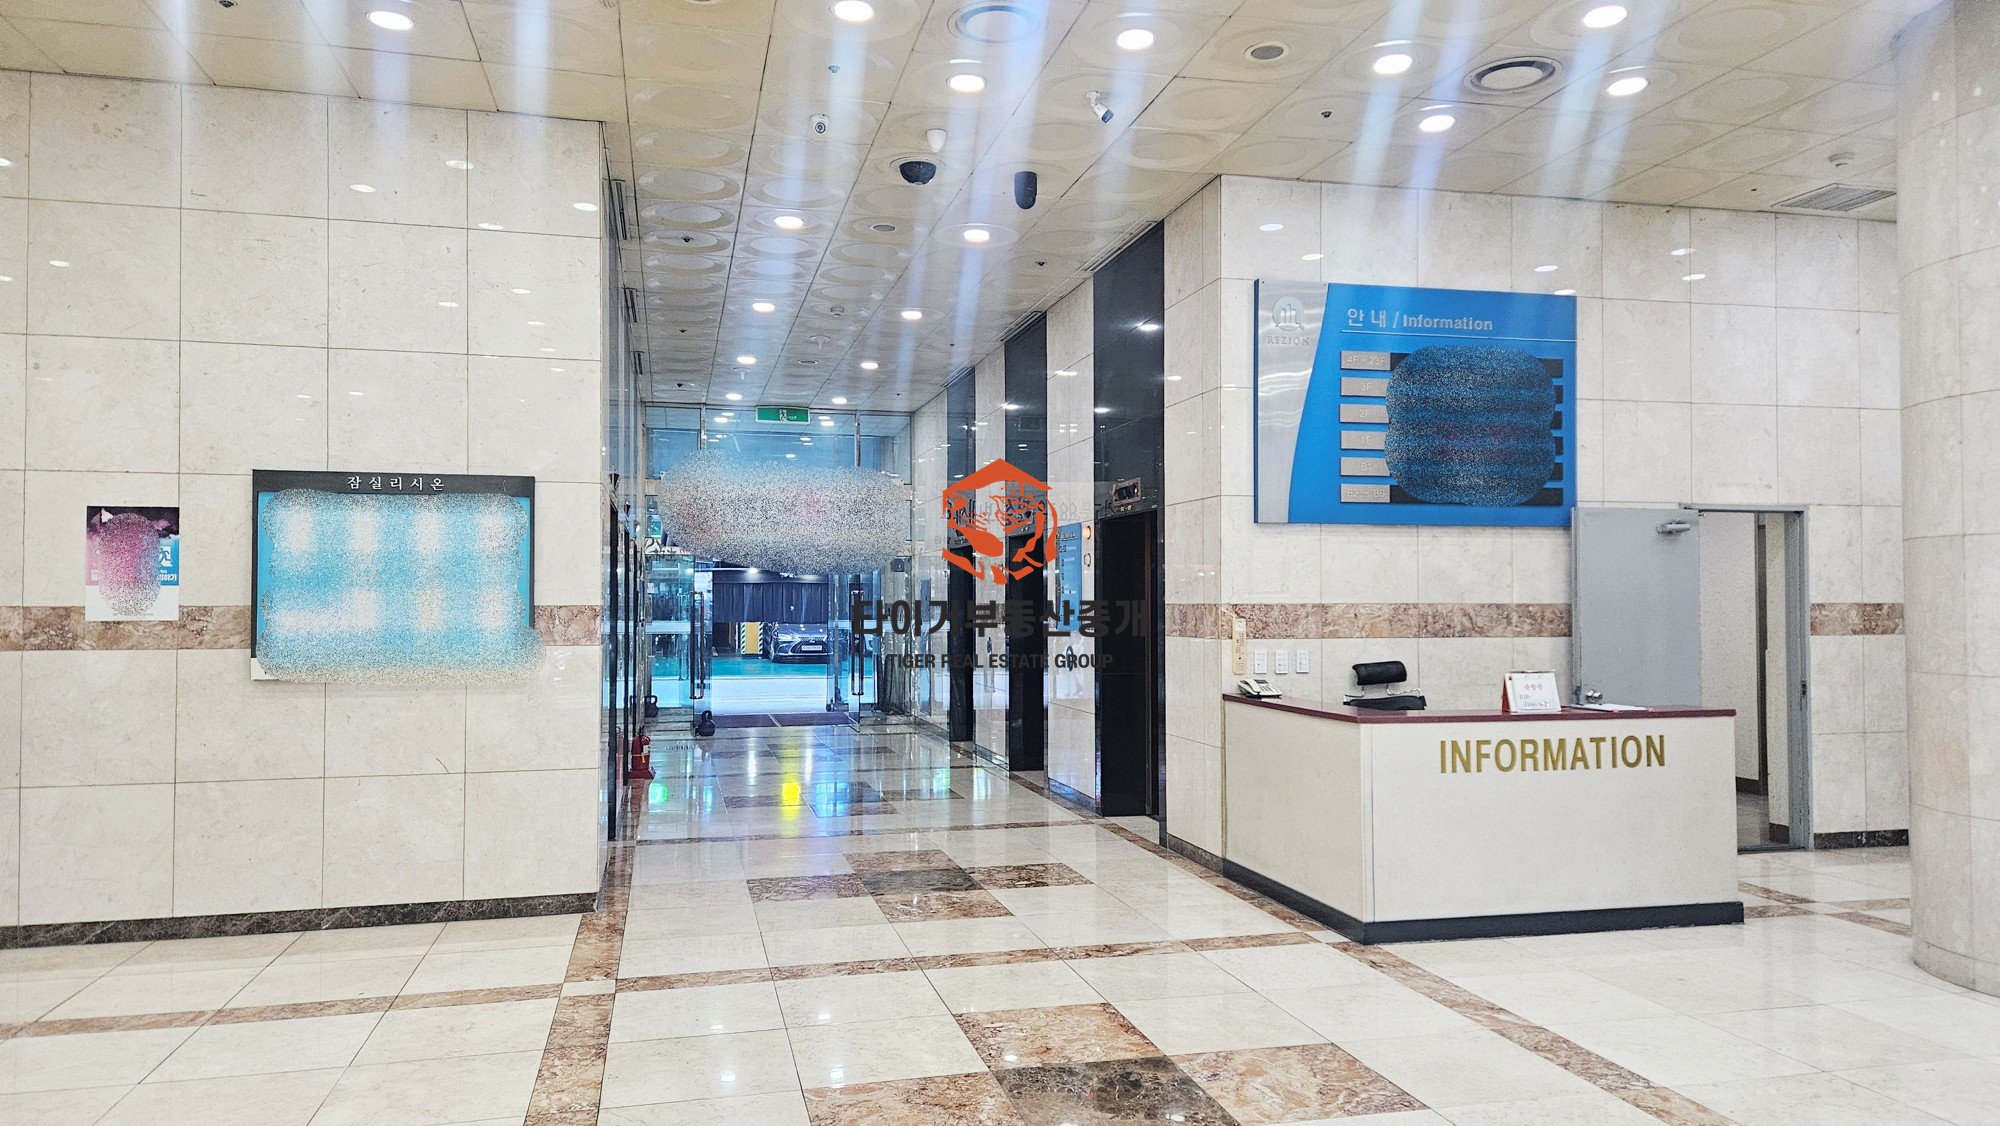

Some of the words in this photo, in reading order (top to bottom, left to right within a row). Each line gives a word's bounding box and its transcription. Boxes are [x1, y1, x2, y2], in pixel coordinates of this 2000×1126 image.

[1403, 314, 1494, 331] Information
[1361, 382, 1372, 391] 3F
[347, 475, 445, 491] 잠실리시온
[1440, 734, 1666, 774] INFORMATION
